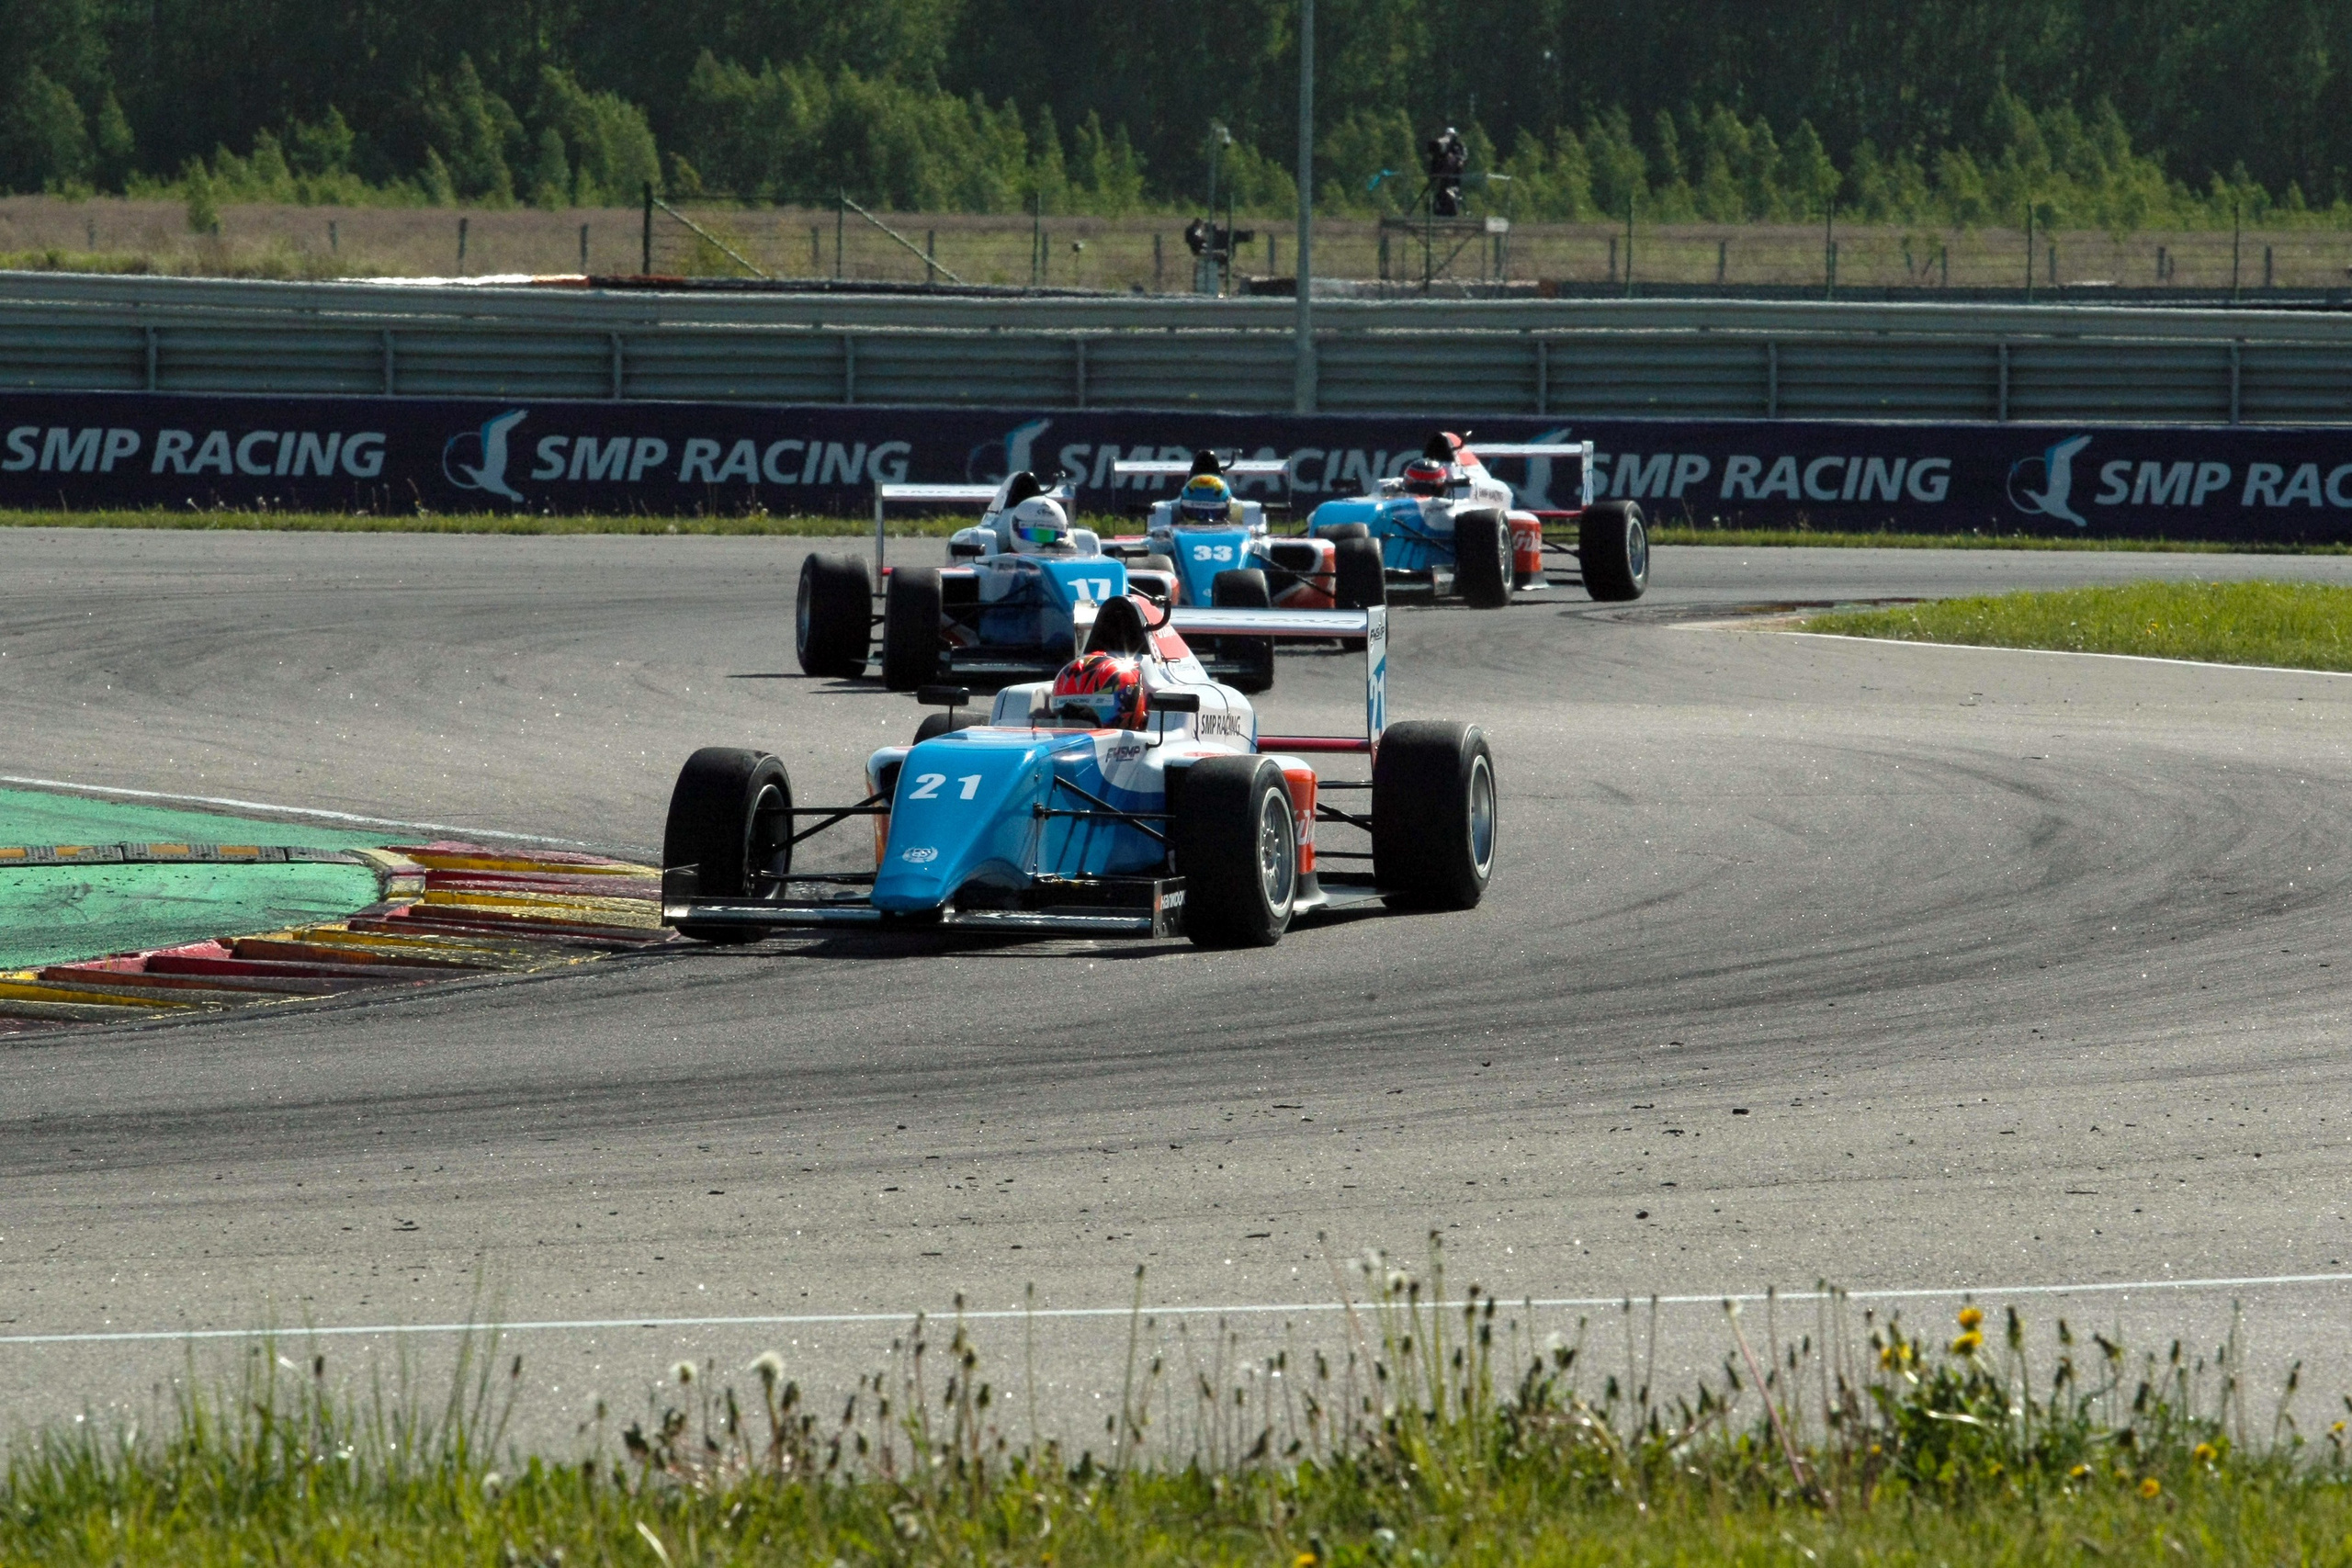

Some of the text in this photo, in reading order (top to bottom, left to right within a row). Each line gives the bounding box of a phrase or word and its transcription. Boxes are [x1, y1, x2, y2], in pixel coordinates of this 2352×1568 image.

[1, 425, 386, 477] SMP RACING
[531, 435, 912, 485] SMP RACING
[1059, 444, 1193, 491] SMP
[1575, 453, 1953, 502] SMP RACING
[2095, 460, 2232, 505] SMP
[1193, 545, 1233, 562] 33
[1067, 578, 1112, 600] 17
[1201, 714, 1240, 737] SMP RACING
[908, 773, 982, 800] 21
